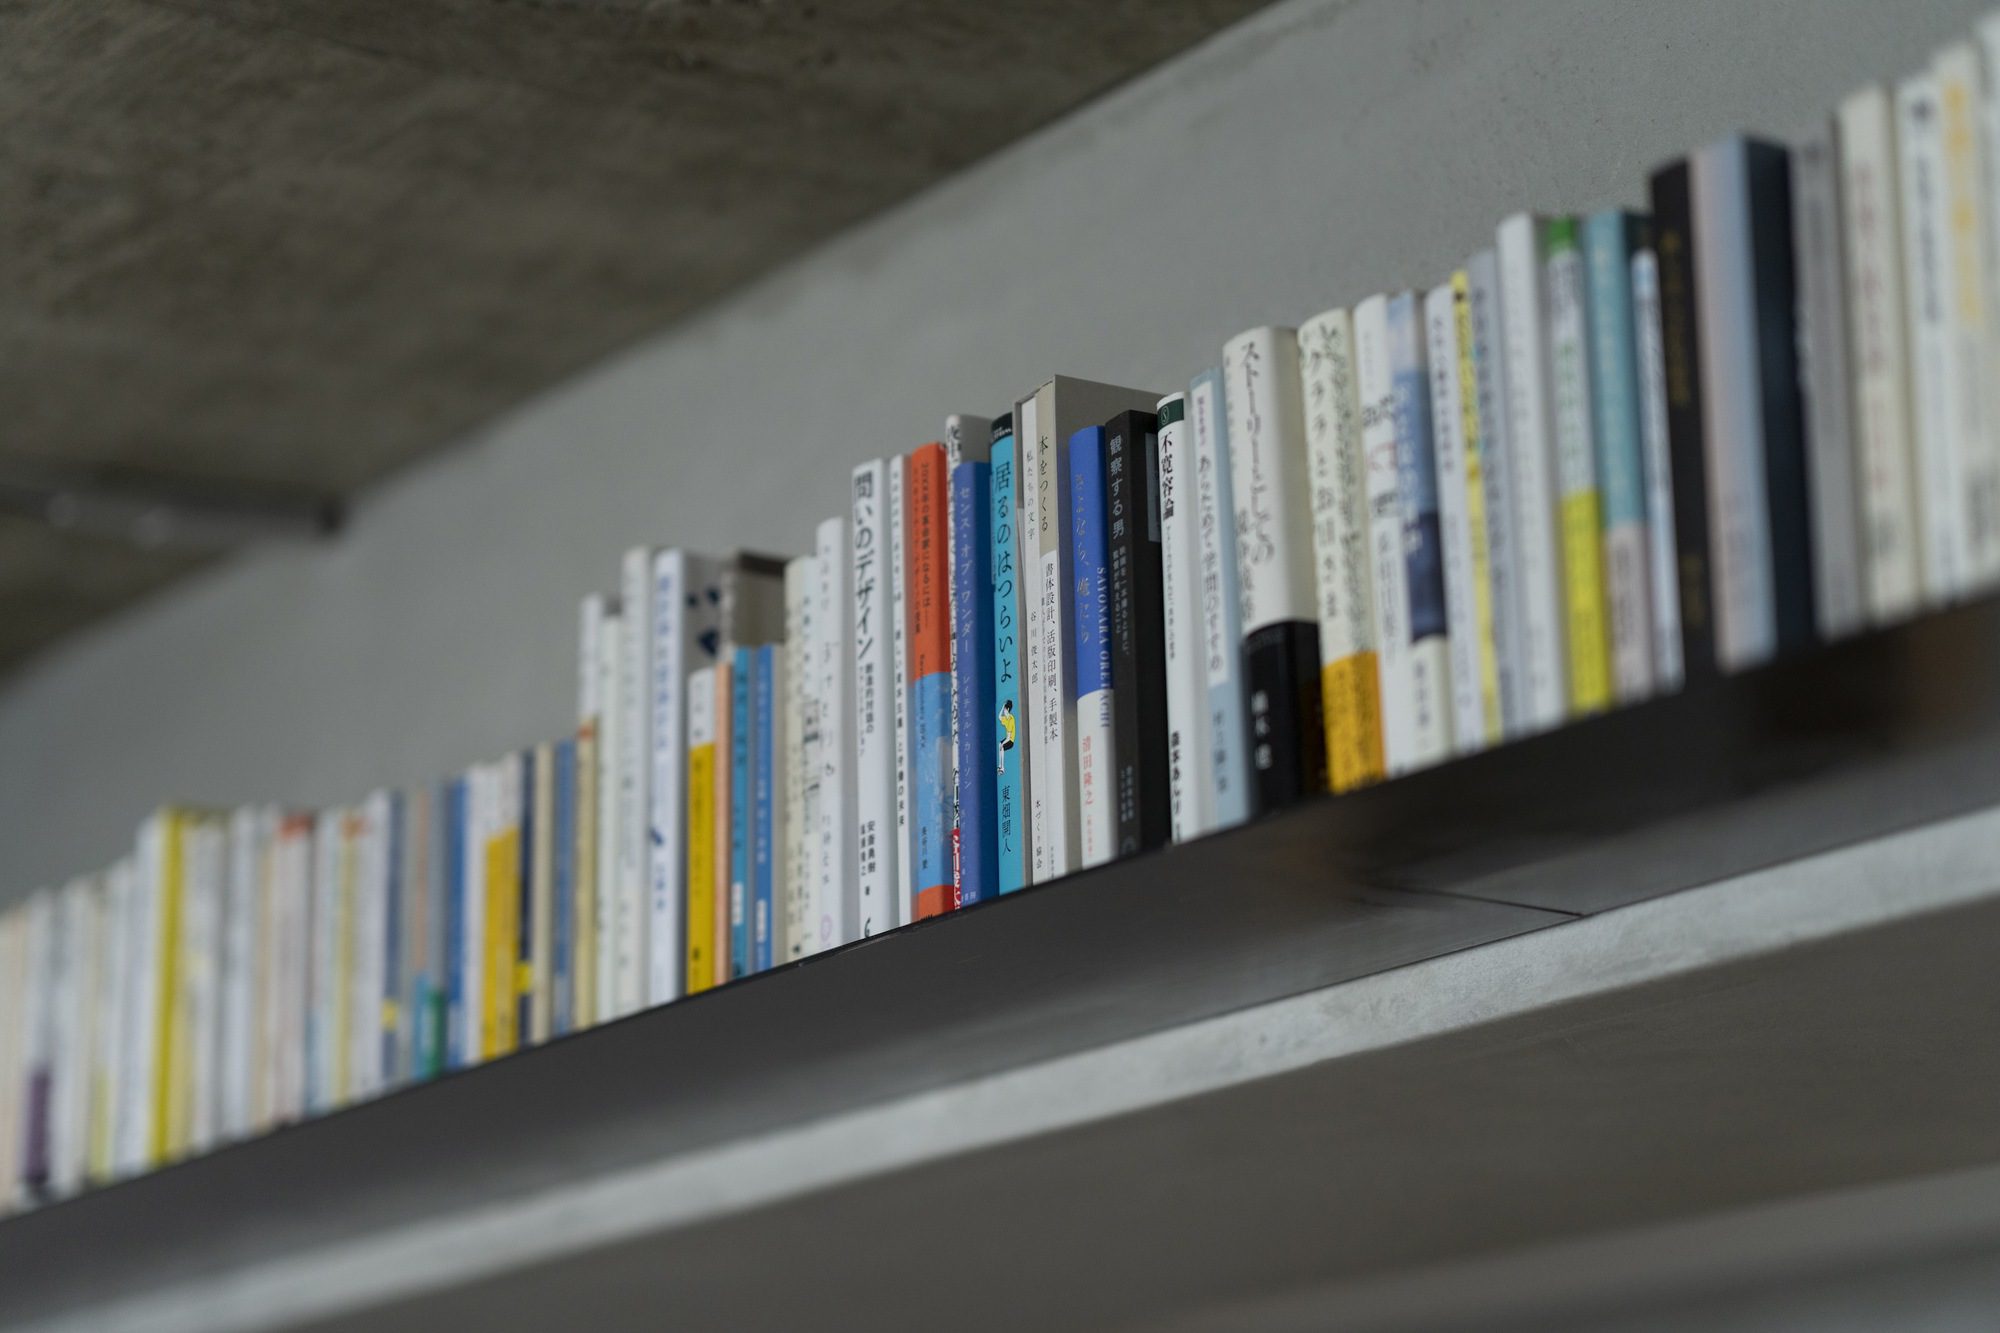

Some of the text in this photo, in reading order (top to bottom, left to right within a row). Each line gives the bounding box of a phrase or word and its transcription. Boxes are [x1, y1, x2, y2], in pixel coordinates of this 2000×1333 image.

[1039, 434, 1049, 534] 本をつくる
[1109, 433, 1126, 542] 観察する男
[854, 470, 874, 660] 問いのデザイン
[959, 486, 974, 654] センス・オブ・ワンダー
[994, 461, 1014, 684] 居るのはつらいよ
[1096, 566, 1111, 645] SAYONARA
[1030, 611, 1039, 686] 谷川俊太郎
[1045, 562, 1060, 746] 書体設計、活版印刷、手製本
[962, 675, 974, 790] レイチェル・カーソン
[1081, 734, 1094, 806] 清田隆之
[1001, 784, 1013, 856] 東畑開人
